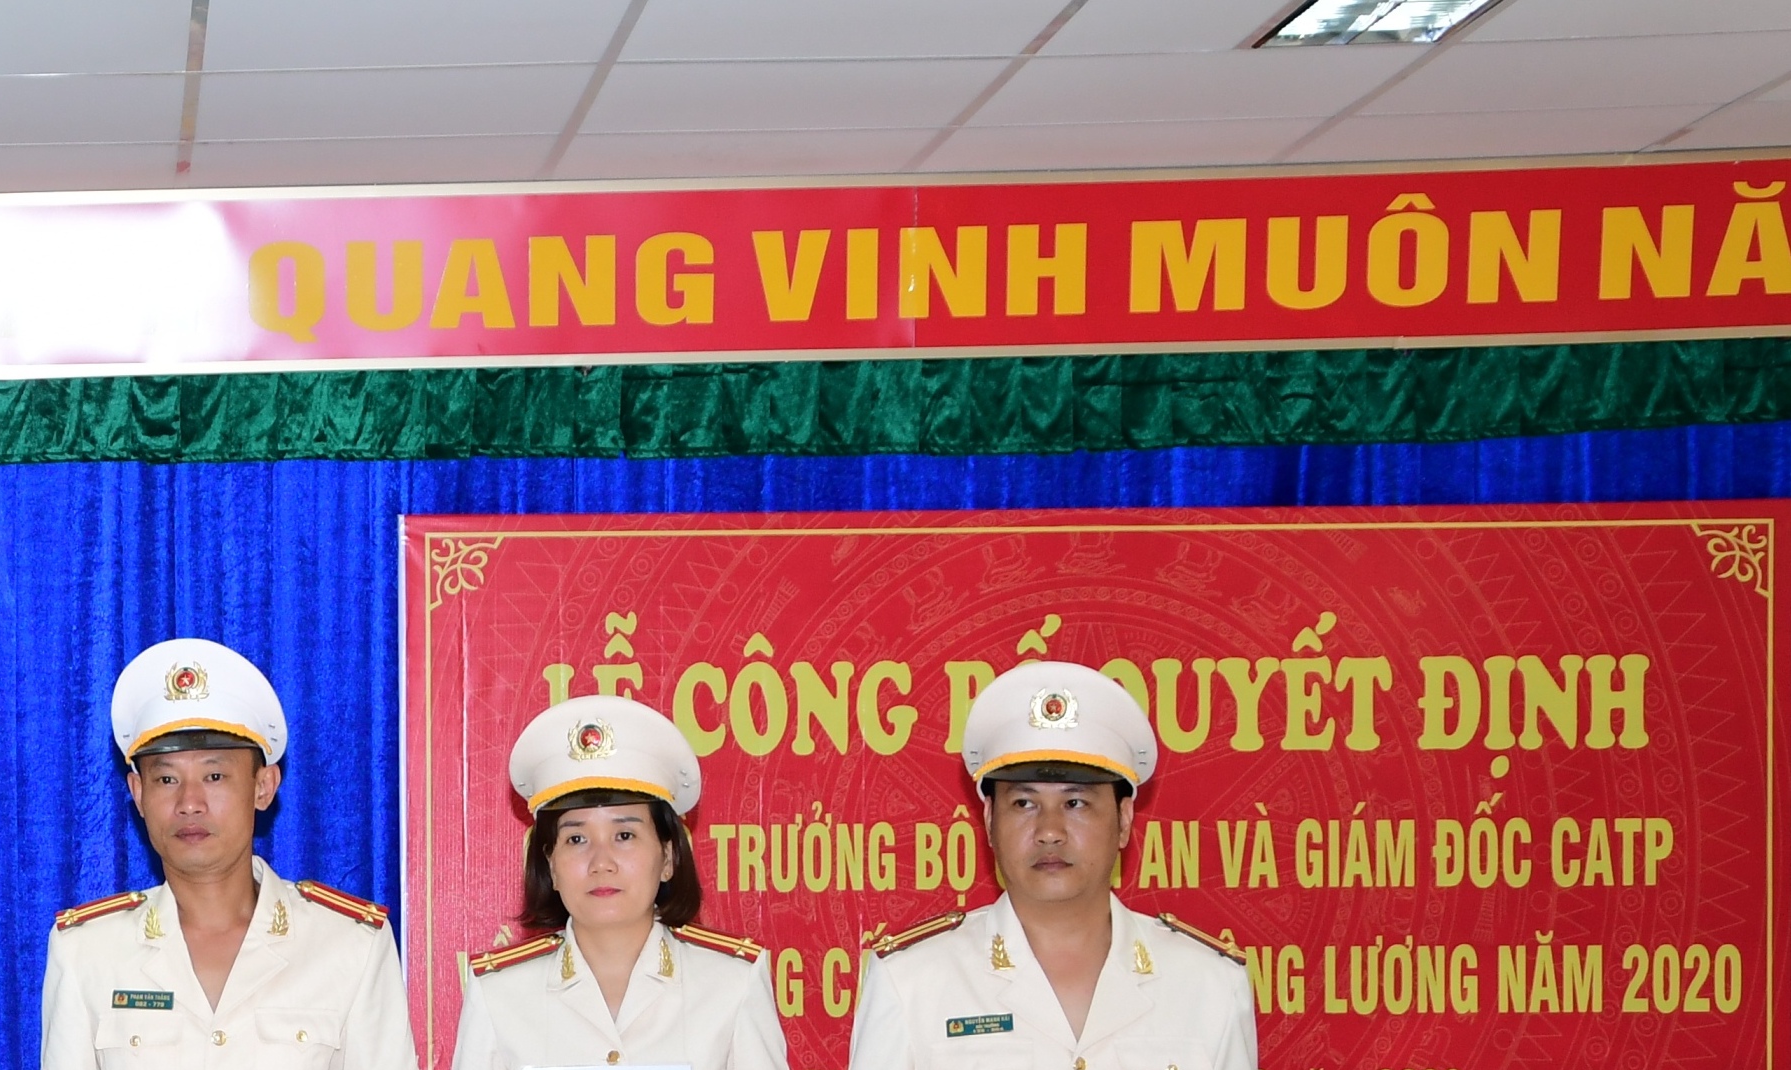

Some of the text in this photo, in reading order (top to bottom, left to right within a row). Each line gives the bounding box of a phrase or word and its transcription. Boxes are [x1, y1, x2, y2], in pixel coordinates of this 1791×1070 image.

[248, 230, 716, 344] QUANG
[752, 223, 1088, 322] VINH
[1128, 193, 1562, 313] MUÔN
[672, 632, 919, 757] CÔNG
[1417, 653, 1651, 780] ĐỊNH
[709, 801, 897, 893] TRƯỞNG
[915, 805, 977, 907] BỘ
[1137, 820, 1200, 890] AN
[1217, 802, 1280, 889] VÀ
[1295, 802, 1416, 890] GIÁM
[1432, 793, 1533, 890] ĐỐC
[1550, 816, 1675, 888] CATP
[1324, 935, 1480, 1016] LƯƠNG
[1498, 932, 1604, 1013] NĂM
[1622, 943, 1743, 1015] 2020
